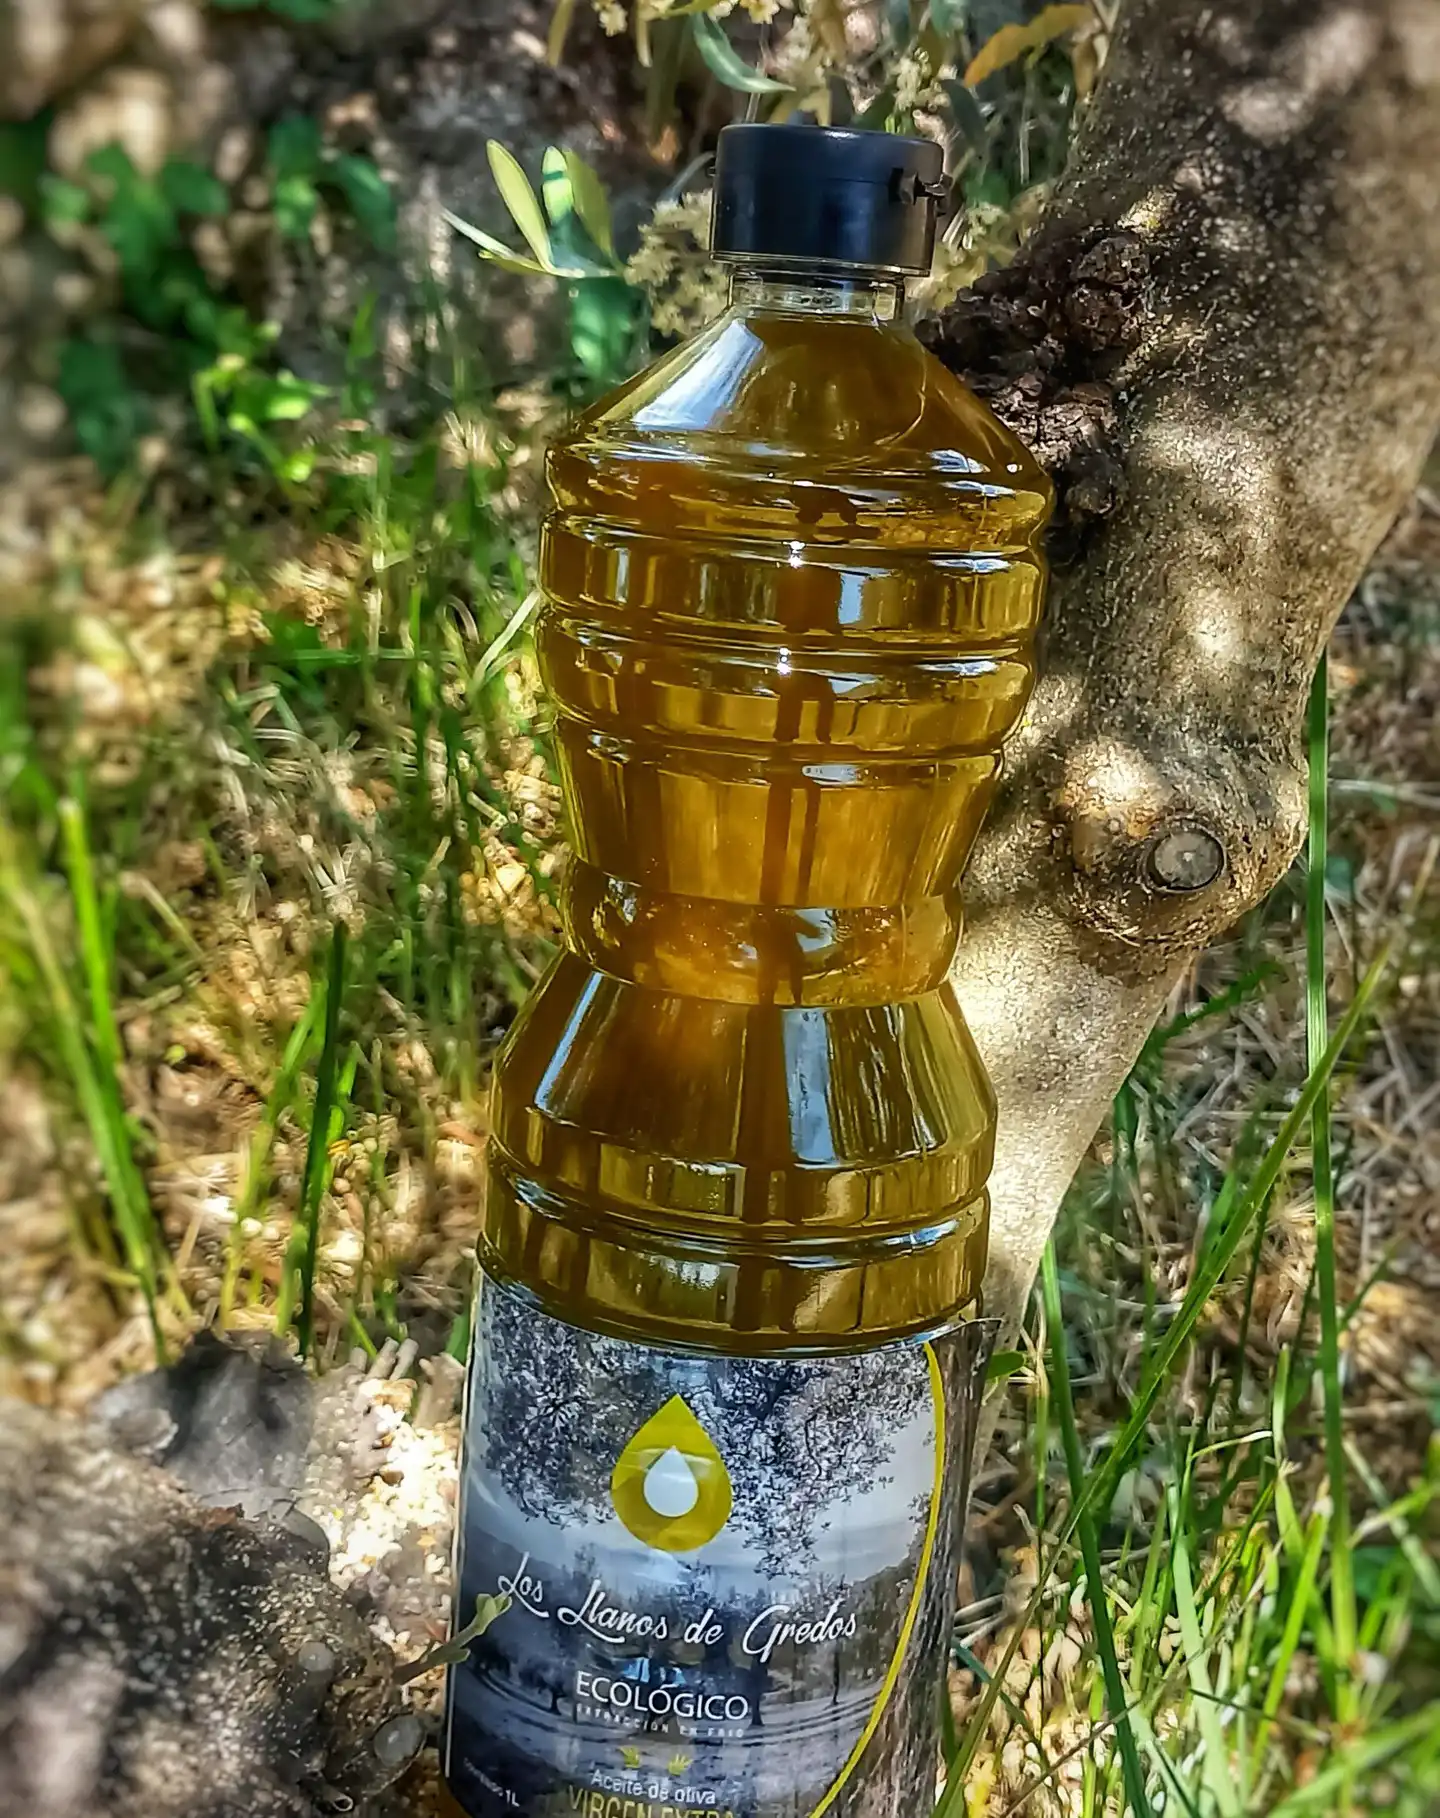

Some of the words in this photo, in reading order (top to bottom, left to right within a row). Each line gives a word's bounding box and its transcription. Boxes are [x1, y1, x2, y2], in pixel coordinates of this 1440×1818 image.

[498, 1552, 549, 1618] Los
[557, 1579, 669, 1643] Llanos
[684, 1609, 724, 1645] de
[742, 1598, 856, 1662] Gredos
[576, 1670, 748, 1720] ECOLÓGICO
[591, 1768, 643, 1796] Aceite
[648, 1781, 668, 1801] de
[675, 1786, 716, 1805] oliva
